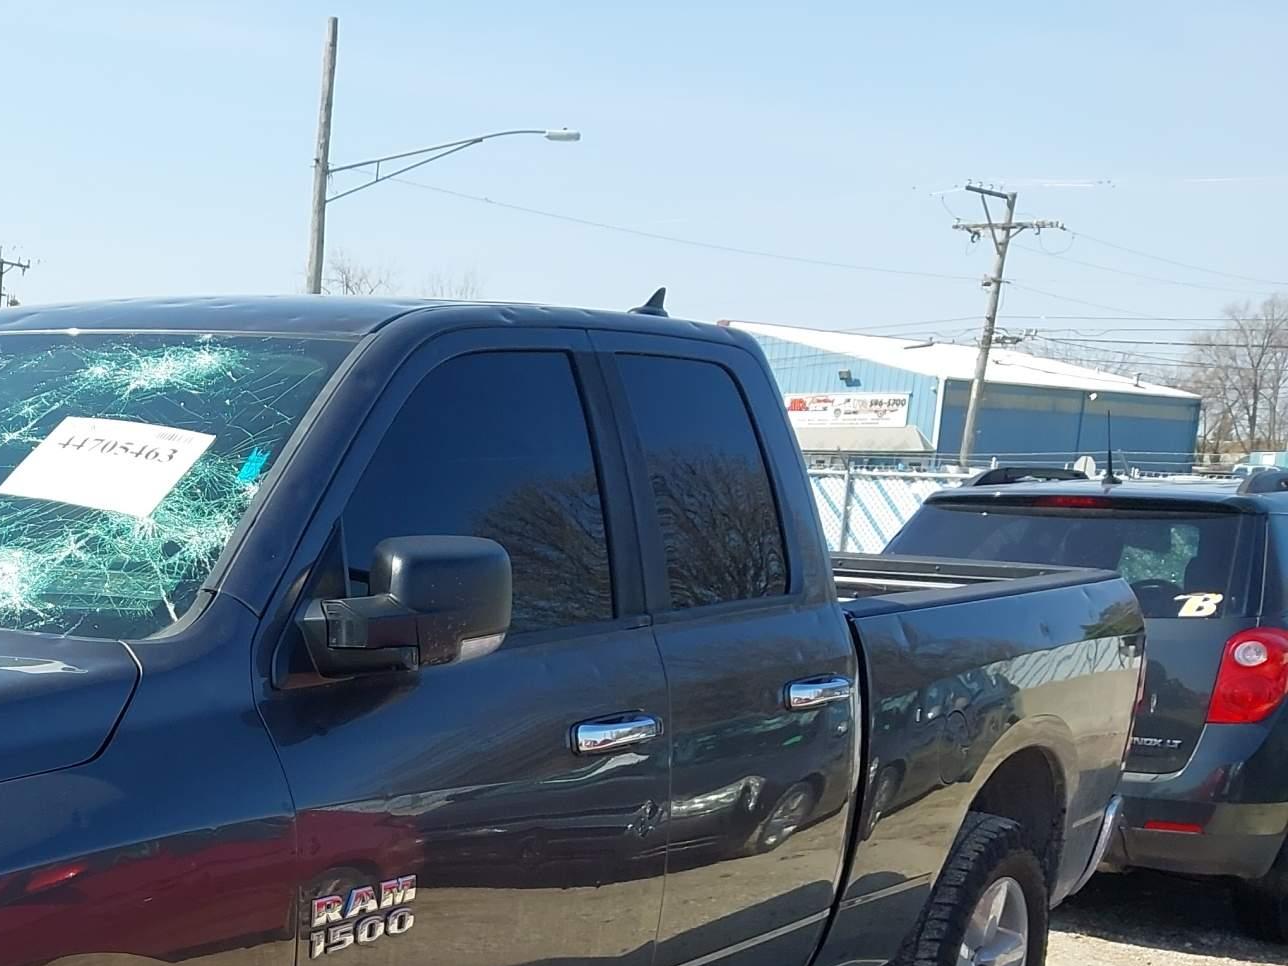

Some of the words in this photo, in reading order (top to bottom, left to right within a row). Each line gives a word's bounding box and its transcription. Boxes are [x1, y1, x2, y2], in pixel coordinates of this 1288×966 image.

[57, 435, 179, 463] 44705463
[1166, 739, 1183, 748] LT
[311, 874, 417, 928] RAM
[309, 906, 415, 960] 1500
